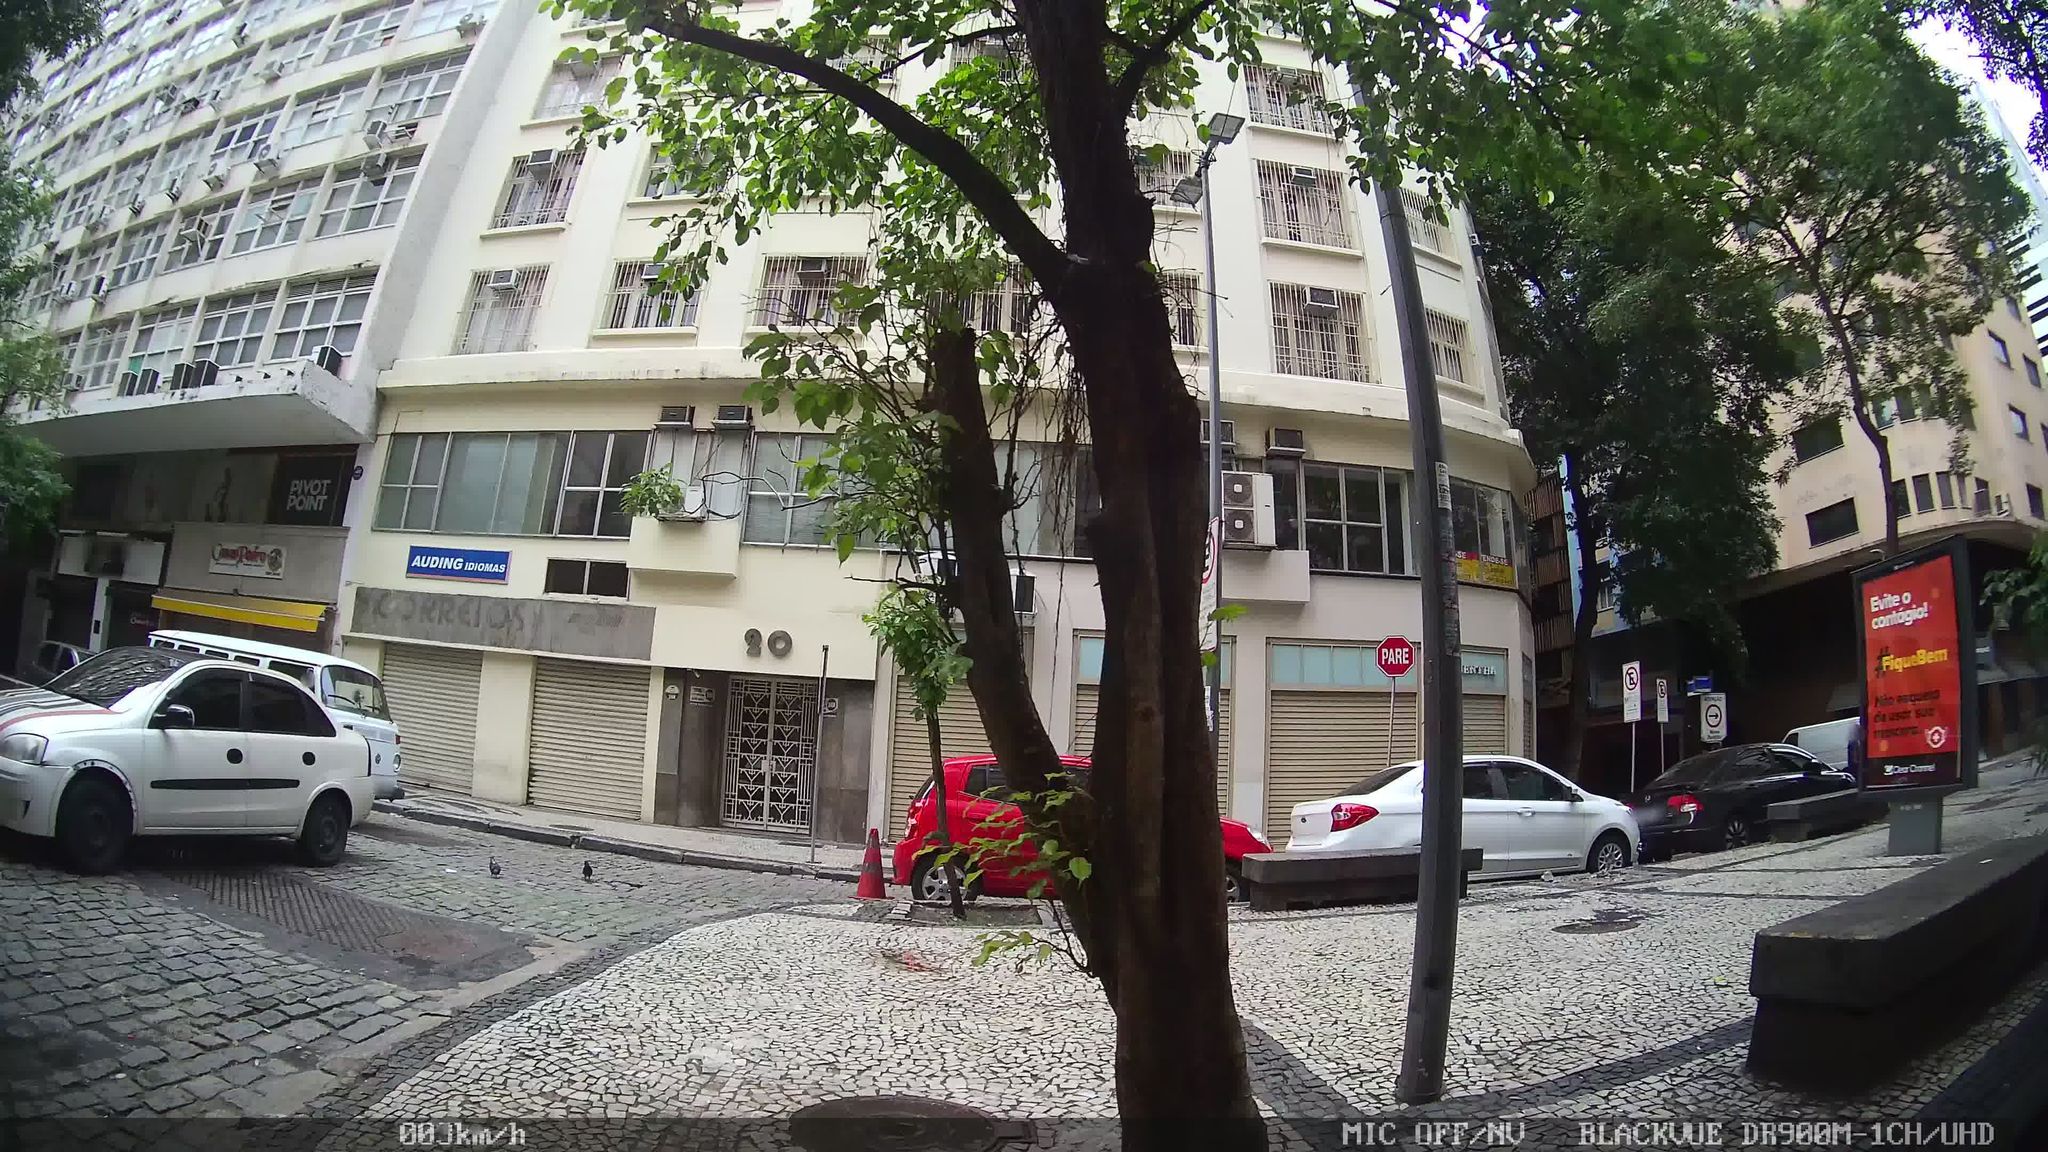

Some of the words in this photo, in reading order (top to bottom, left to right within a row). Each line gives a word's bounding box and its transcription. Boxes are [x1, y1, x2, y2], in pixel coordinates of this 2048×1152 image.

[290, 479, 332, 495] PIVOT
[286, 495, 328, 511] POINT
[410, 555, 464, 570] AUDING
[464, 562, 506, 573] IDIOMAS
[1870, 594, 1900, 612] Evite
[1902, 592, 1911, 604] o
[1871, 602, 1929, 630] contágio!
[744, 628, 793, 657] 20
[1381, 647, 1410, 665] PARE
